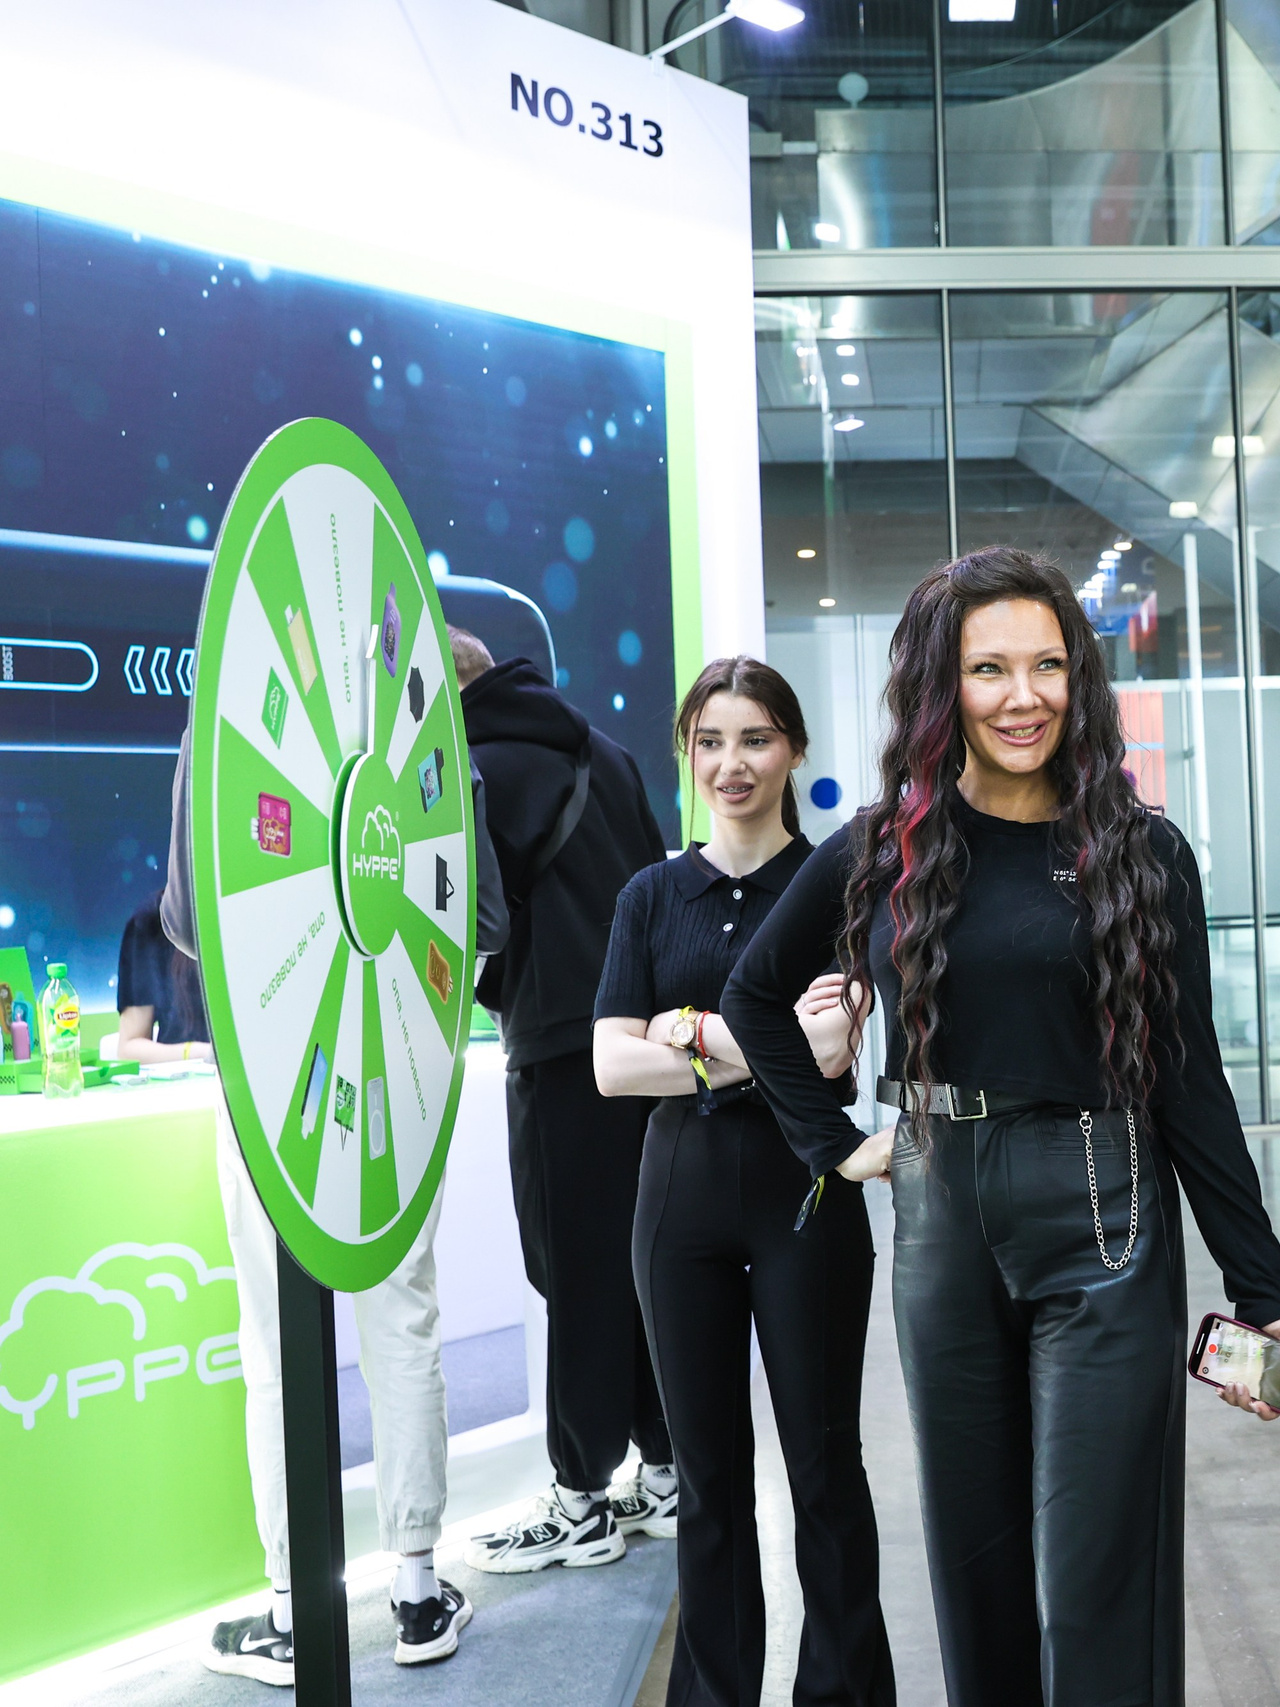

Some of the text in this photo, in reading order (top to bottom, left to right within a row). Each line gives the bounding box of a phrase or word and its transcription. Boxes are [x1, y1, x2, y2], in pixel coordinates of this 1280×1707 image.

[510, 73, 665, 158] NO.313
[329, 513, 344, 613] повезло
[2, 645, 14, 681] BOOST
[339, 619, 347, 647] не
[352, 852, 399, 881] HYPPE
[260, 911, 325, 1010] опа, не повезло
[391, 978, 428, 1122] опа, не повезло
[0, 1331, 243, 1431] YPPE
[528, 1523, 554, 1544] N
